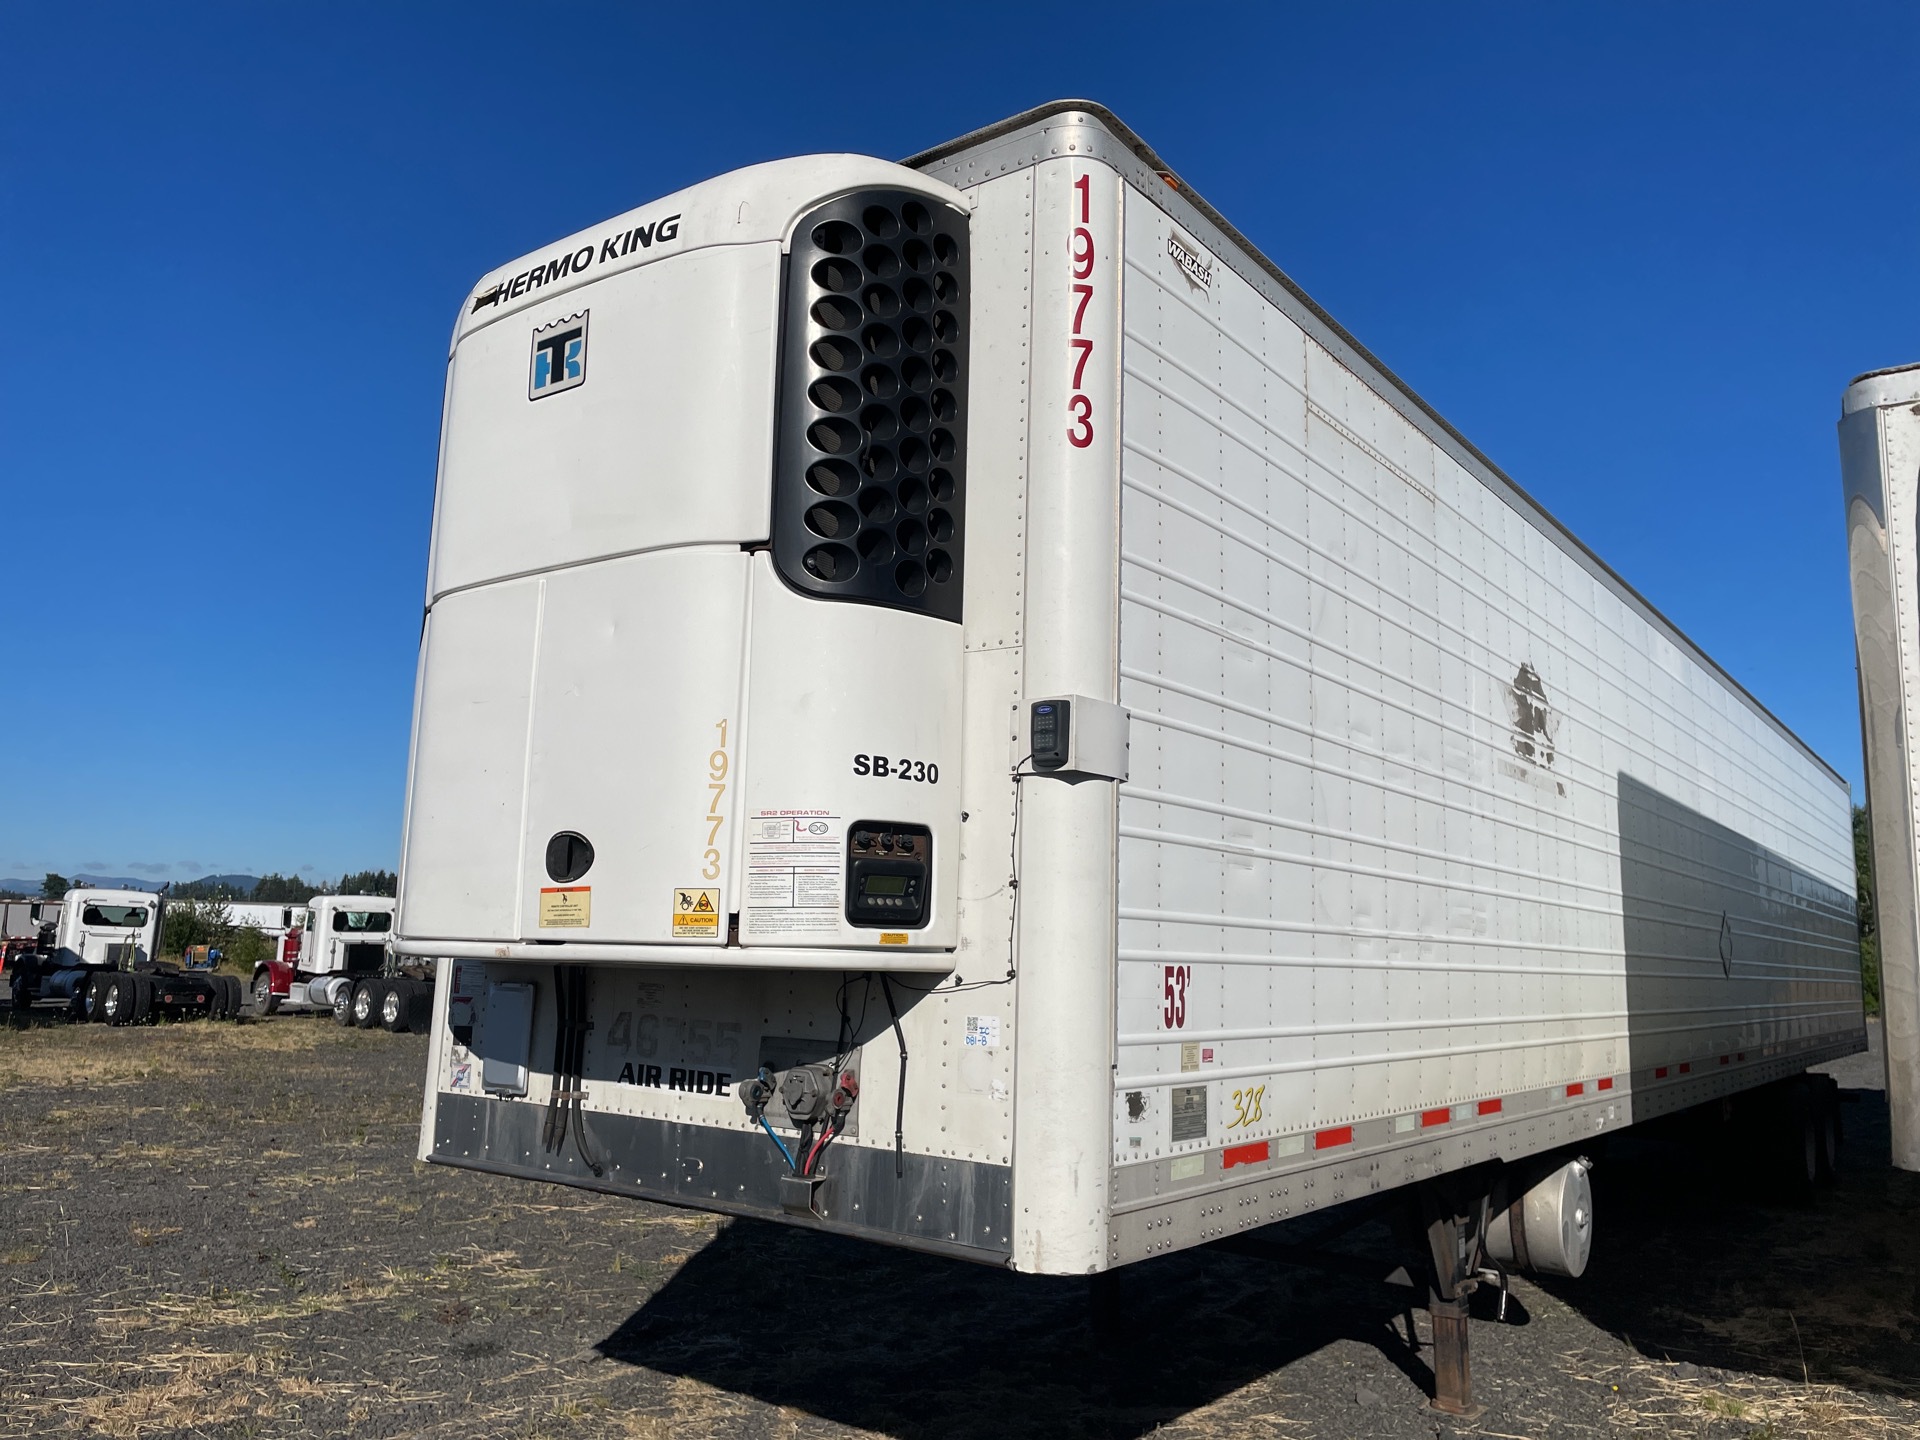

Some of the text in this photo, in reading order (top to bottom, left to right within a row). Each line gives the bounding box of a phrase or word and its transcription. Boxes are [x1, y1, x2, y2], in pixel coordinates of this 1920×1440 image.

[599, 213, 682, 264] KING
[1168, 239, 1212, 287] WABASH
[1066, 173, 1095, 448] 19773
[853, 754, 938, 784] SB-230
[702, 718, 728, 880] 19773
[1164, 965, 1191, 1029] 53'
[617, 1062, 731, 1097] AIR RIDE
[1226, 1084, 1266, 1129] 328
